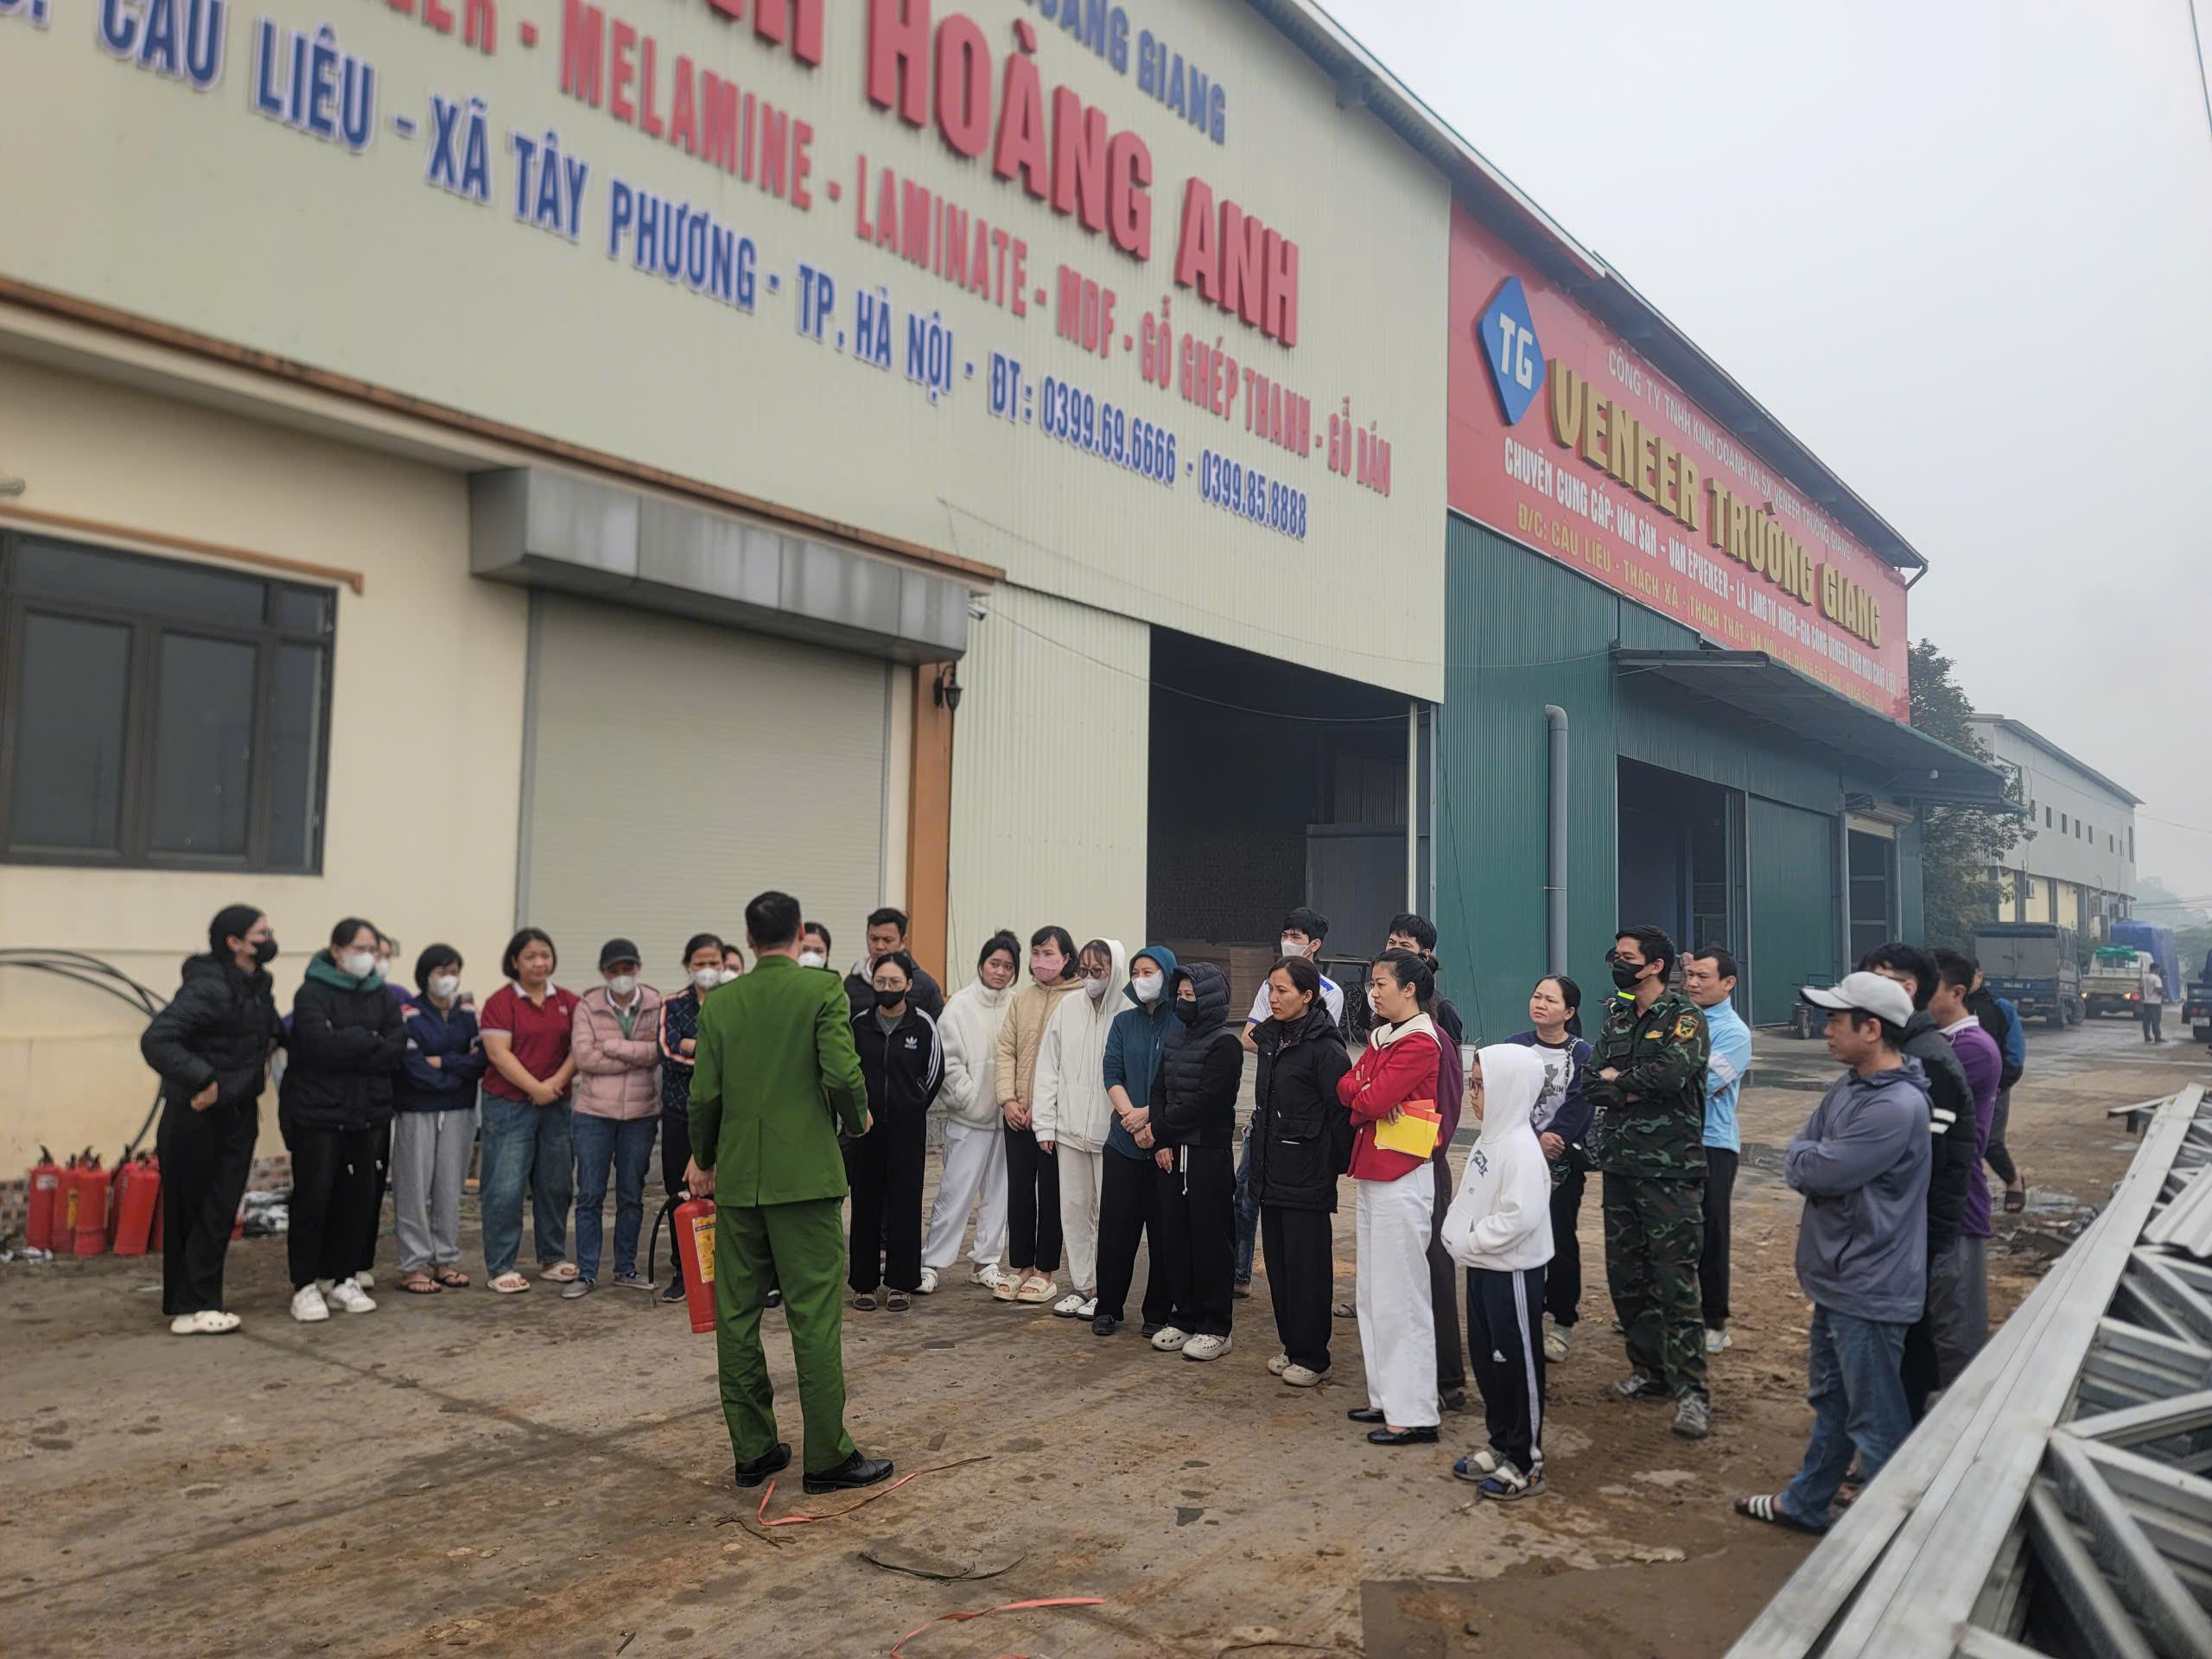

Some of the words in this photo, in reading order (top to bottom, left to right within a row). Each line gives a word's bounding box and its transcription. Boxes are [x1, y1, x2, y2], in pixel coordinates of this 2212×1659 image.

[866, 0, 1153, 262] HOÀNG
[1175, 175, 1299, 348] ANH
[1137, 29, 1226, 145] GIANG
[424, 92, 493, 207] XÃ
[507, 128, 590, 245] TÂY
[607, 176, 757, 313] PHƯƠNG
[853, 286, 893, 372] HÀ
[904, 309, 955, 406] NỘI
[1039, 374, 1177, 486] 0399.69.6666
[1199, 448, 1307, 543] 0399.85.8888
[559, 0, 813, 211] MELAMINE
[855, 153, 1028, 319] LAMINATE
[1056, 264, 1116, 359] MDF
[1180, 332, 1239, 423] GHÉP
[1242, 365, 1311, 459] THANH
[1498, 312, 1534, 391] TG
[1504, 435, 1553, 499] CHUYÊN
[1556, 467, 1588, 518] CUNG
[1550, 356, 1700, 533] VENEER
[1705, 476, 1813, 607] TRƯỜNG
[1819, 561, 1881, 650] GIANG
[1608, 346, 1641, 397] CÔNG
[1646, 378, 1660, 412] TY
[1664, 393, 1691, 435] TNHH
[1693, 416, 1715, 453] KINH
[1716, 437, 1746, 481] DOANH
[1761, 474, 1771, 499] SX
[1773, 484, 1801, 520] VENEER
[1830, 531, 1852, 561] GIANG
